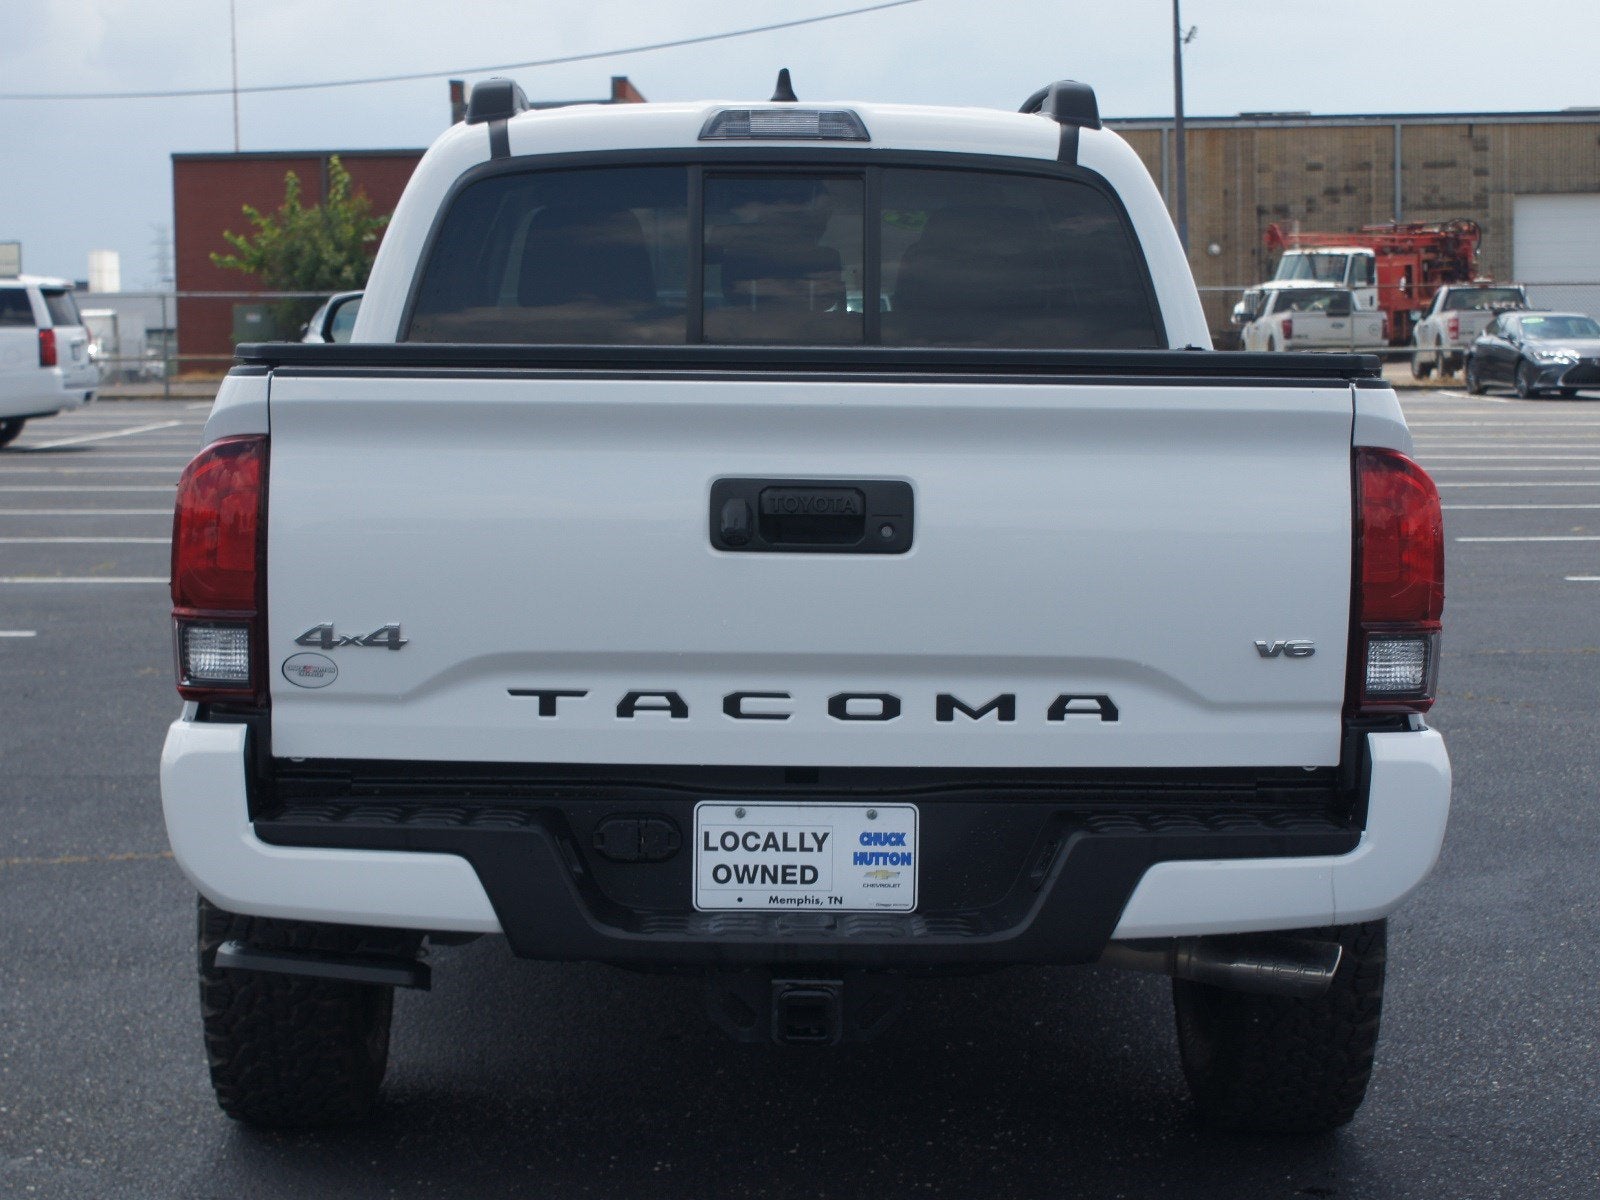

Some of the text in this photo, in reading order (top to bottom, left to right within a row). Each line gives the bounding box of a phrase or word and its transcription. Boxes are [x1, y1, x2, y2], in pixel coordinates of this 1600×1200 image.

[769, 495, 859, 514] TOYOTA
[295, 622, 408, 650] 4x4
[1255, 639, 1316, 658] V6
[507, 688, 1119, 723] TACOMA
[703, 830, 831, 853] LOCALLY
[859, 831, 907, 847] CHUCK
[853, 851, 912, 866] HUTTON
[712, 863, 819, 885] OWNED
[768, 895, 843, 907] Memphis, TN
